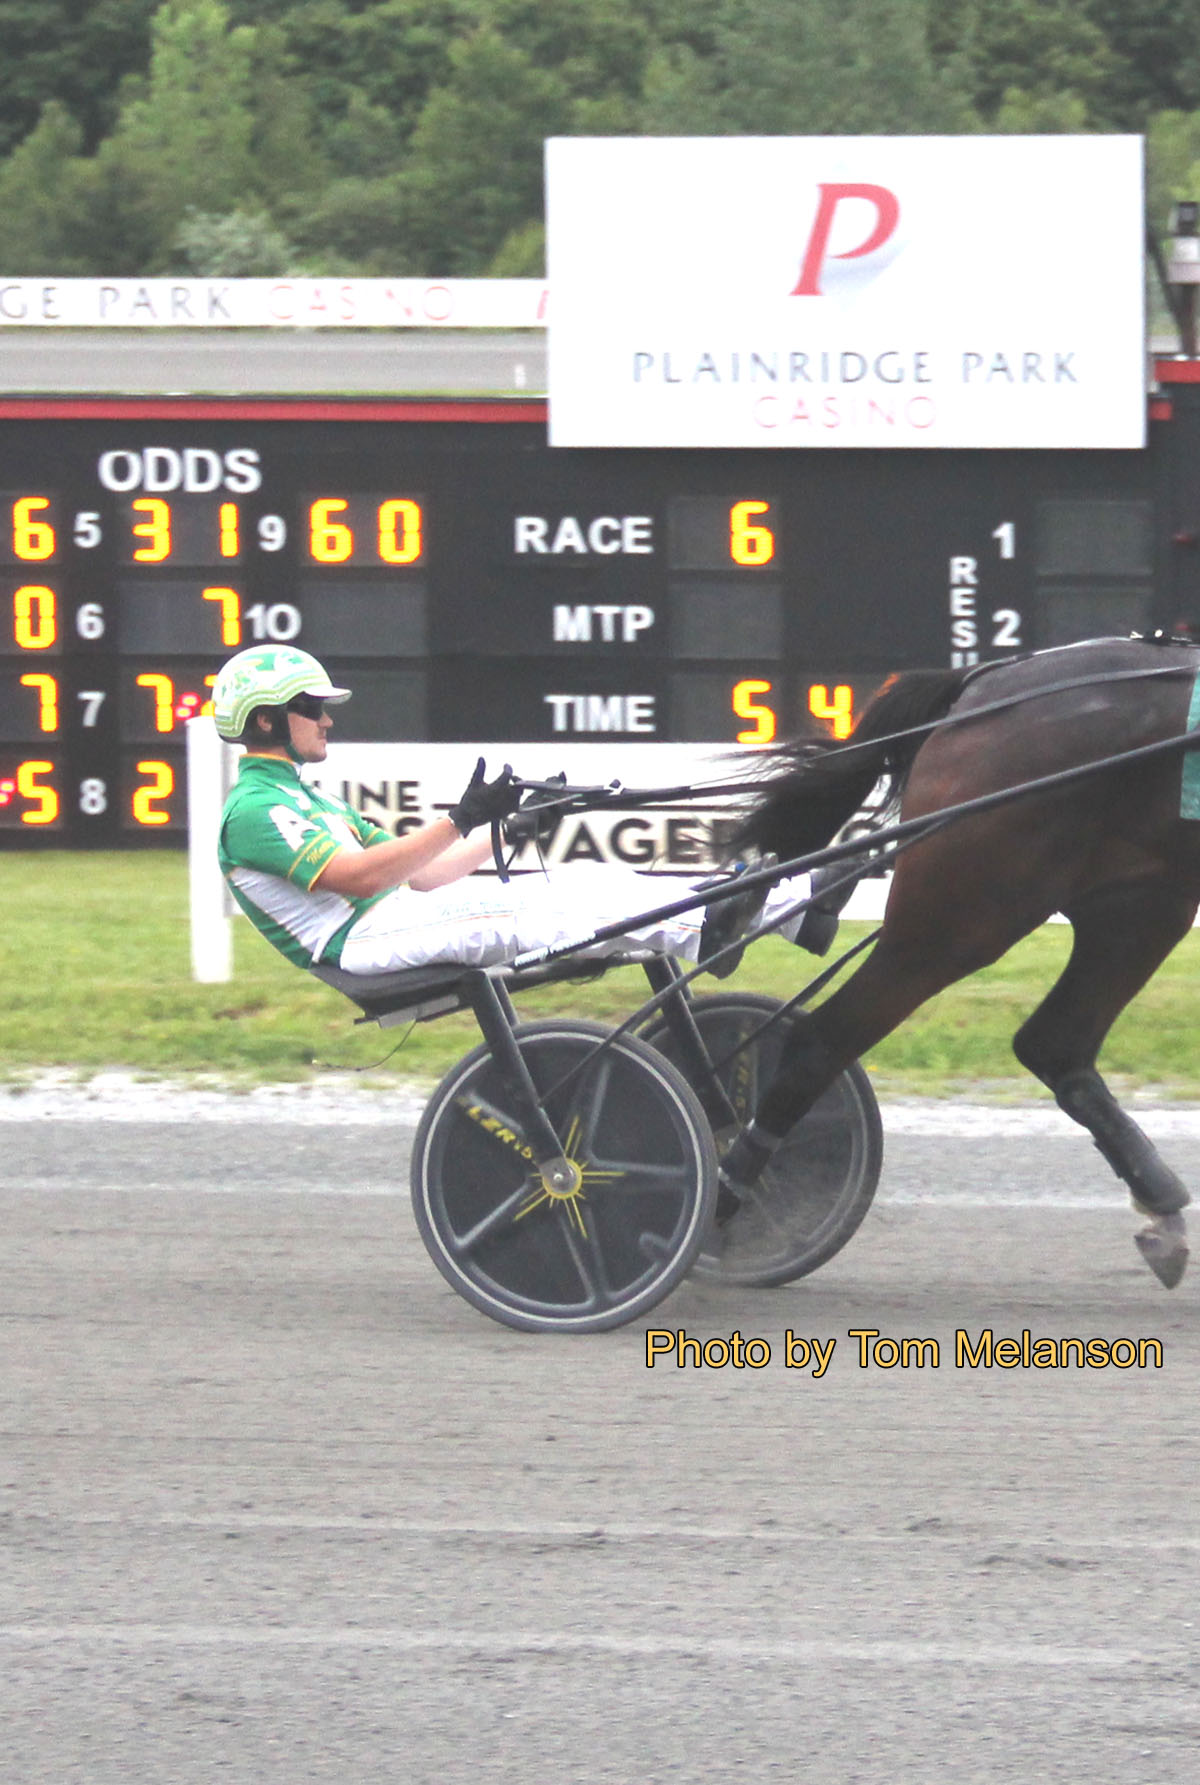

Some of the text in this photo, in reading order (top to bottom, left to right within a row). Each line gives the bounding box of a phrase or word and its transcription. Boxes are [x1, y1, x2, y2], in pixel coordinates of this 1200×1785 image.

[790, 183, 899, 295] P
[99, 286, 232, 319] PARK
[268, 285, 454, 320] CASNO
[632, 352, 1078, 383] PLAINRIDGE PARK
[752, 397, 936, 428] CASINO
[98, 448, 261, 493] ODDS
[13, 497, 56, 560] 6
[74, 512, 101, 548] 5
[257, 514, 285, 552] 9
[514, 517, 653, 554] RACE
[730, 501, 774, 565] 6
[992, 523, 1015, 559] 1
[76, 602, 105, 639] 6
[203, 587, 240, 646] 7
[244, 603, 301, 640] 10
[553, 605, 654, 642] MTP
[992, 610, 1020, 646] 2
[78, 691, 105, 727] 7
[545, 696, 655, 732] TIME
[79, 779, 106, 814] 8
[313, 780, 422, 812] INE
